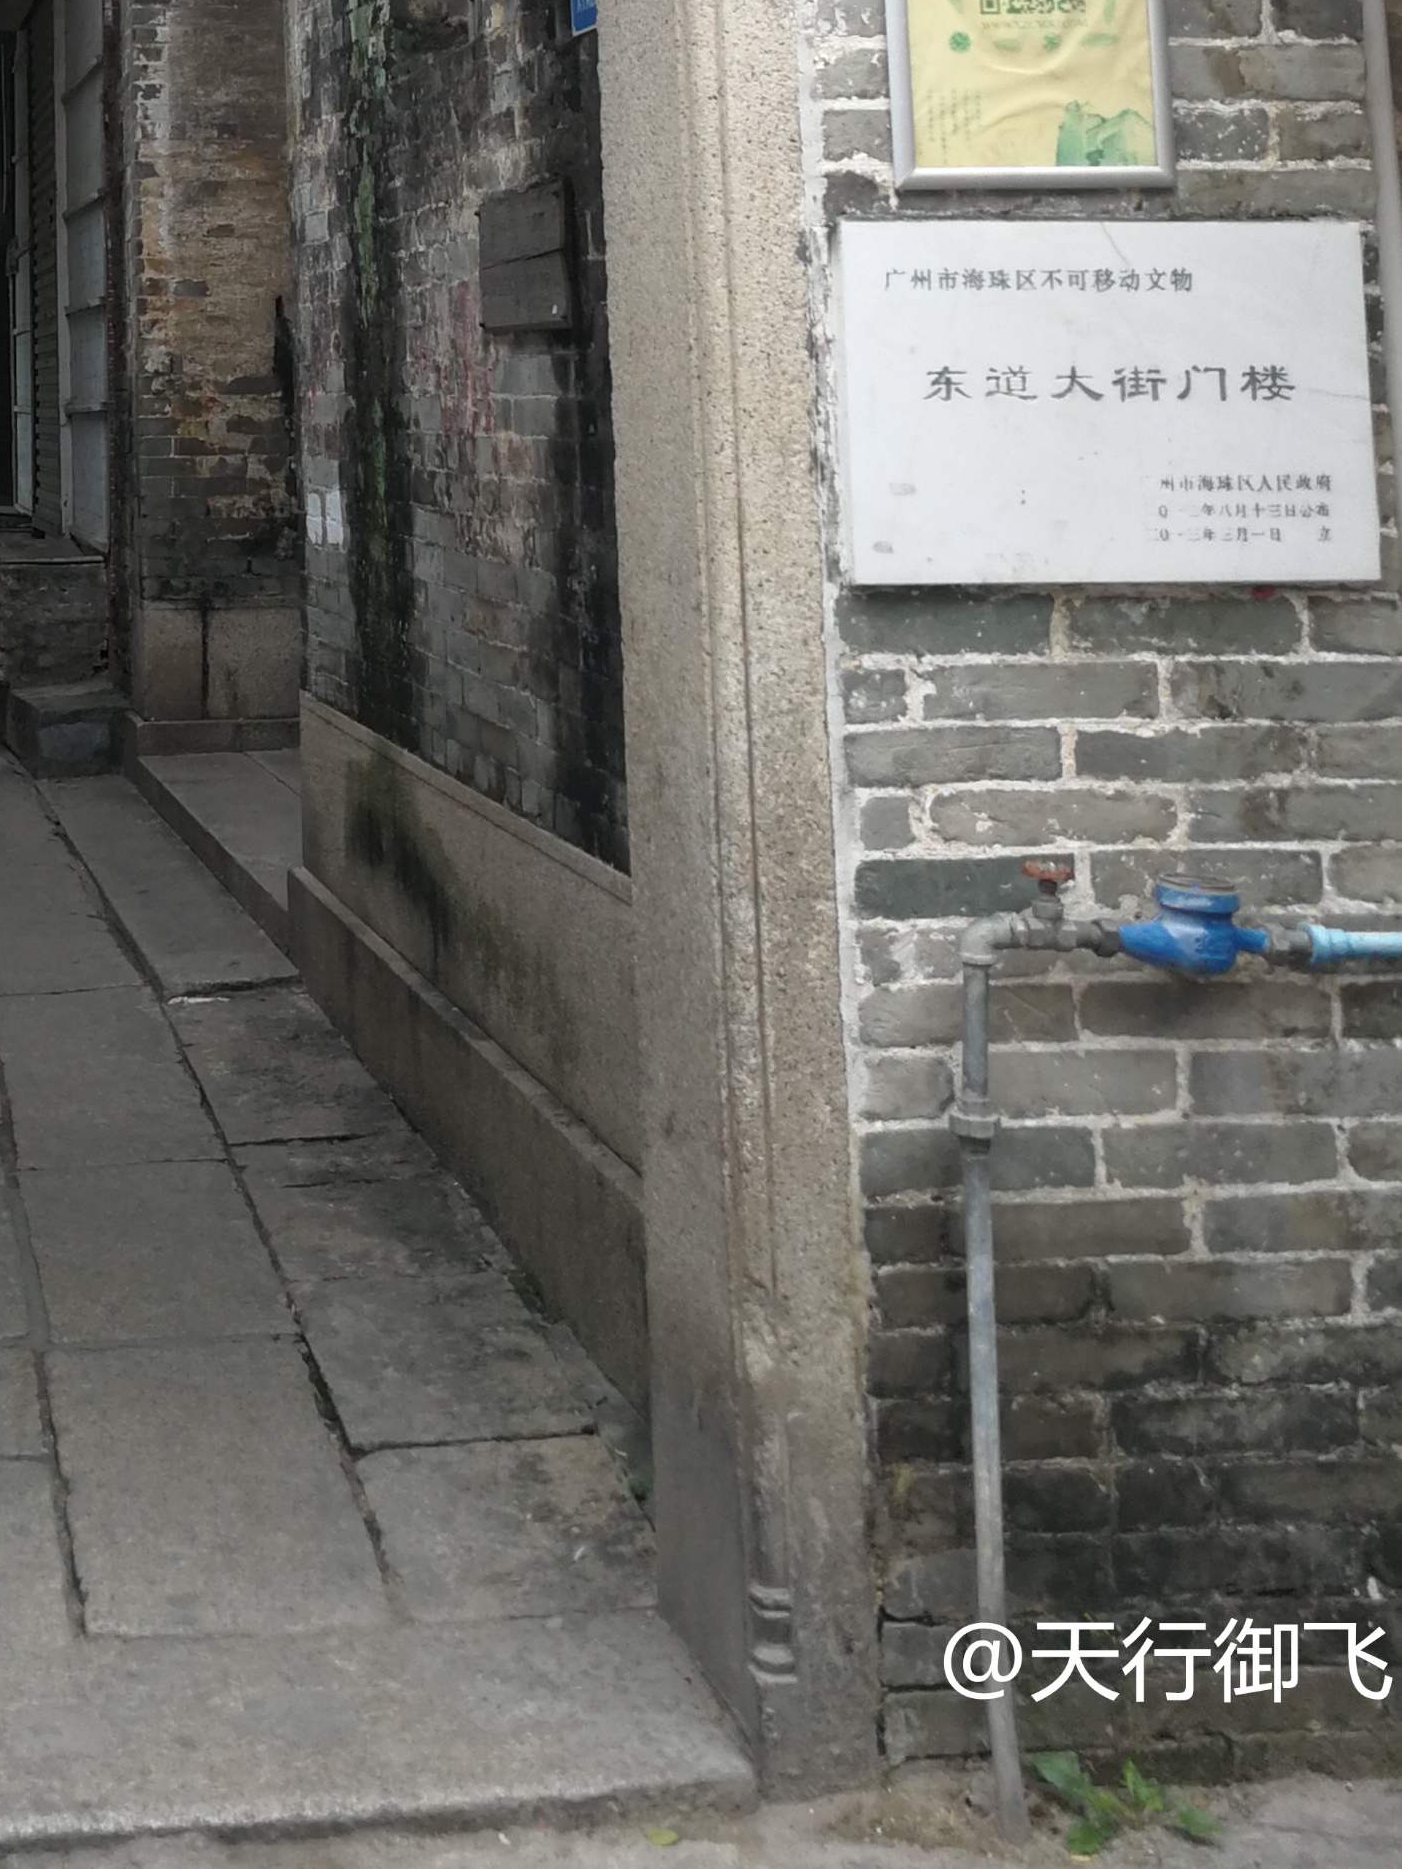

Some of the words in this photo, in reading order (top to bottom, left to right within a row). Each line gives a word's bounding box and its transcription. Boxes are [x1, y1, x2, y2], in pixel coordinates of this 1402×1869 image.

[884, 267, 1194, 293] 广州市海珠区不可移动文物
[923, 364, 1296, 403] 东道大街门楼
[1154, 474, 1332, 492] 州市海珠区人民政府
